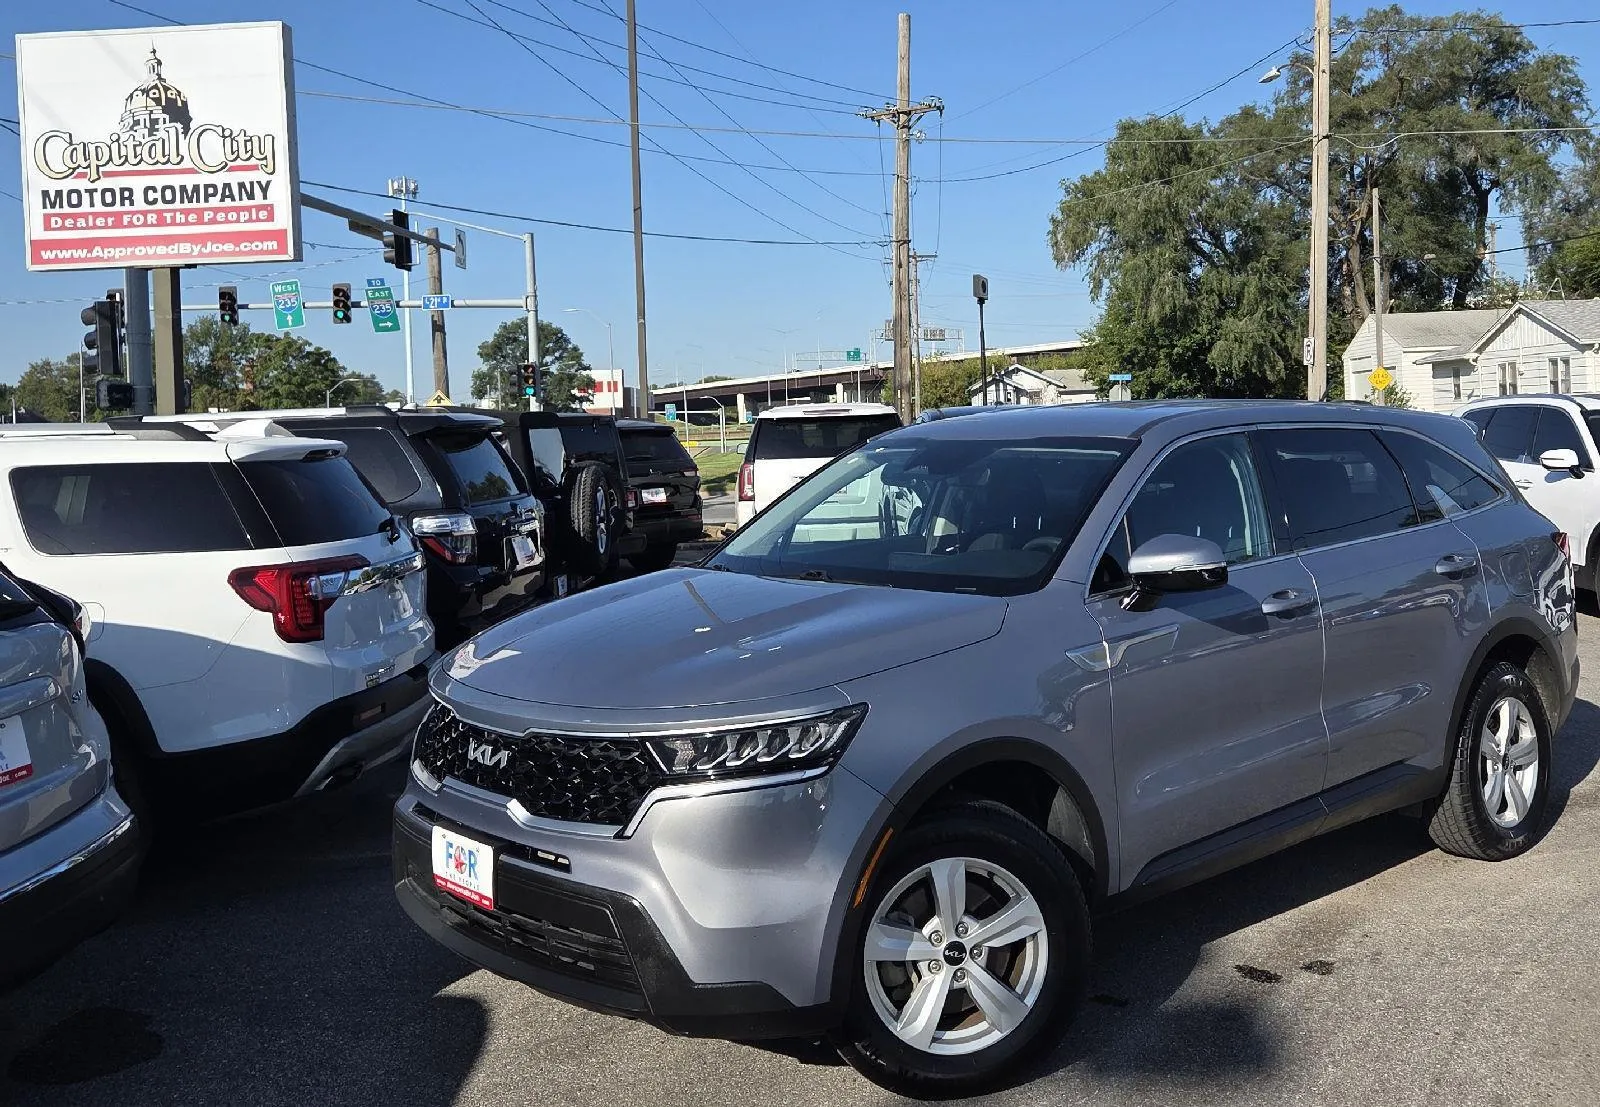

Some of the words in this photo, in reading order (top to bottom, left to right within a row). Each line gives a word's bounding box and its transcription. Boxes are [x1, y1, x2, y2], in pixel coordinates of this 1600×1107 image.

[34, 125, 185, 183] Capital
[188, 124, 276, 175] City
[41, 186, 135, 210] MOTOR
[143, 180, 272, 206] COMPANY
[50, 215, 115, 228] Dealer
[122, 212, 158, 226] FOR
[163, 210, 198, 224] The
[203, 207, 269, 223] People
[40, 239, 278, 260] www.ApprovedByJoe.com
[274, 284, 297, 293] WEST
[367, 290, 390, 298] EAST
[279, 298, 298, 309] 235
[372, 303, 392, 313] 235
[468, 738, 511, 769] KIA
[445, 840, 479, 881] FOR
